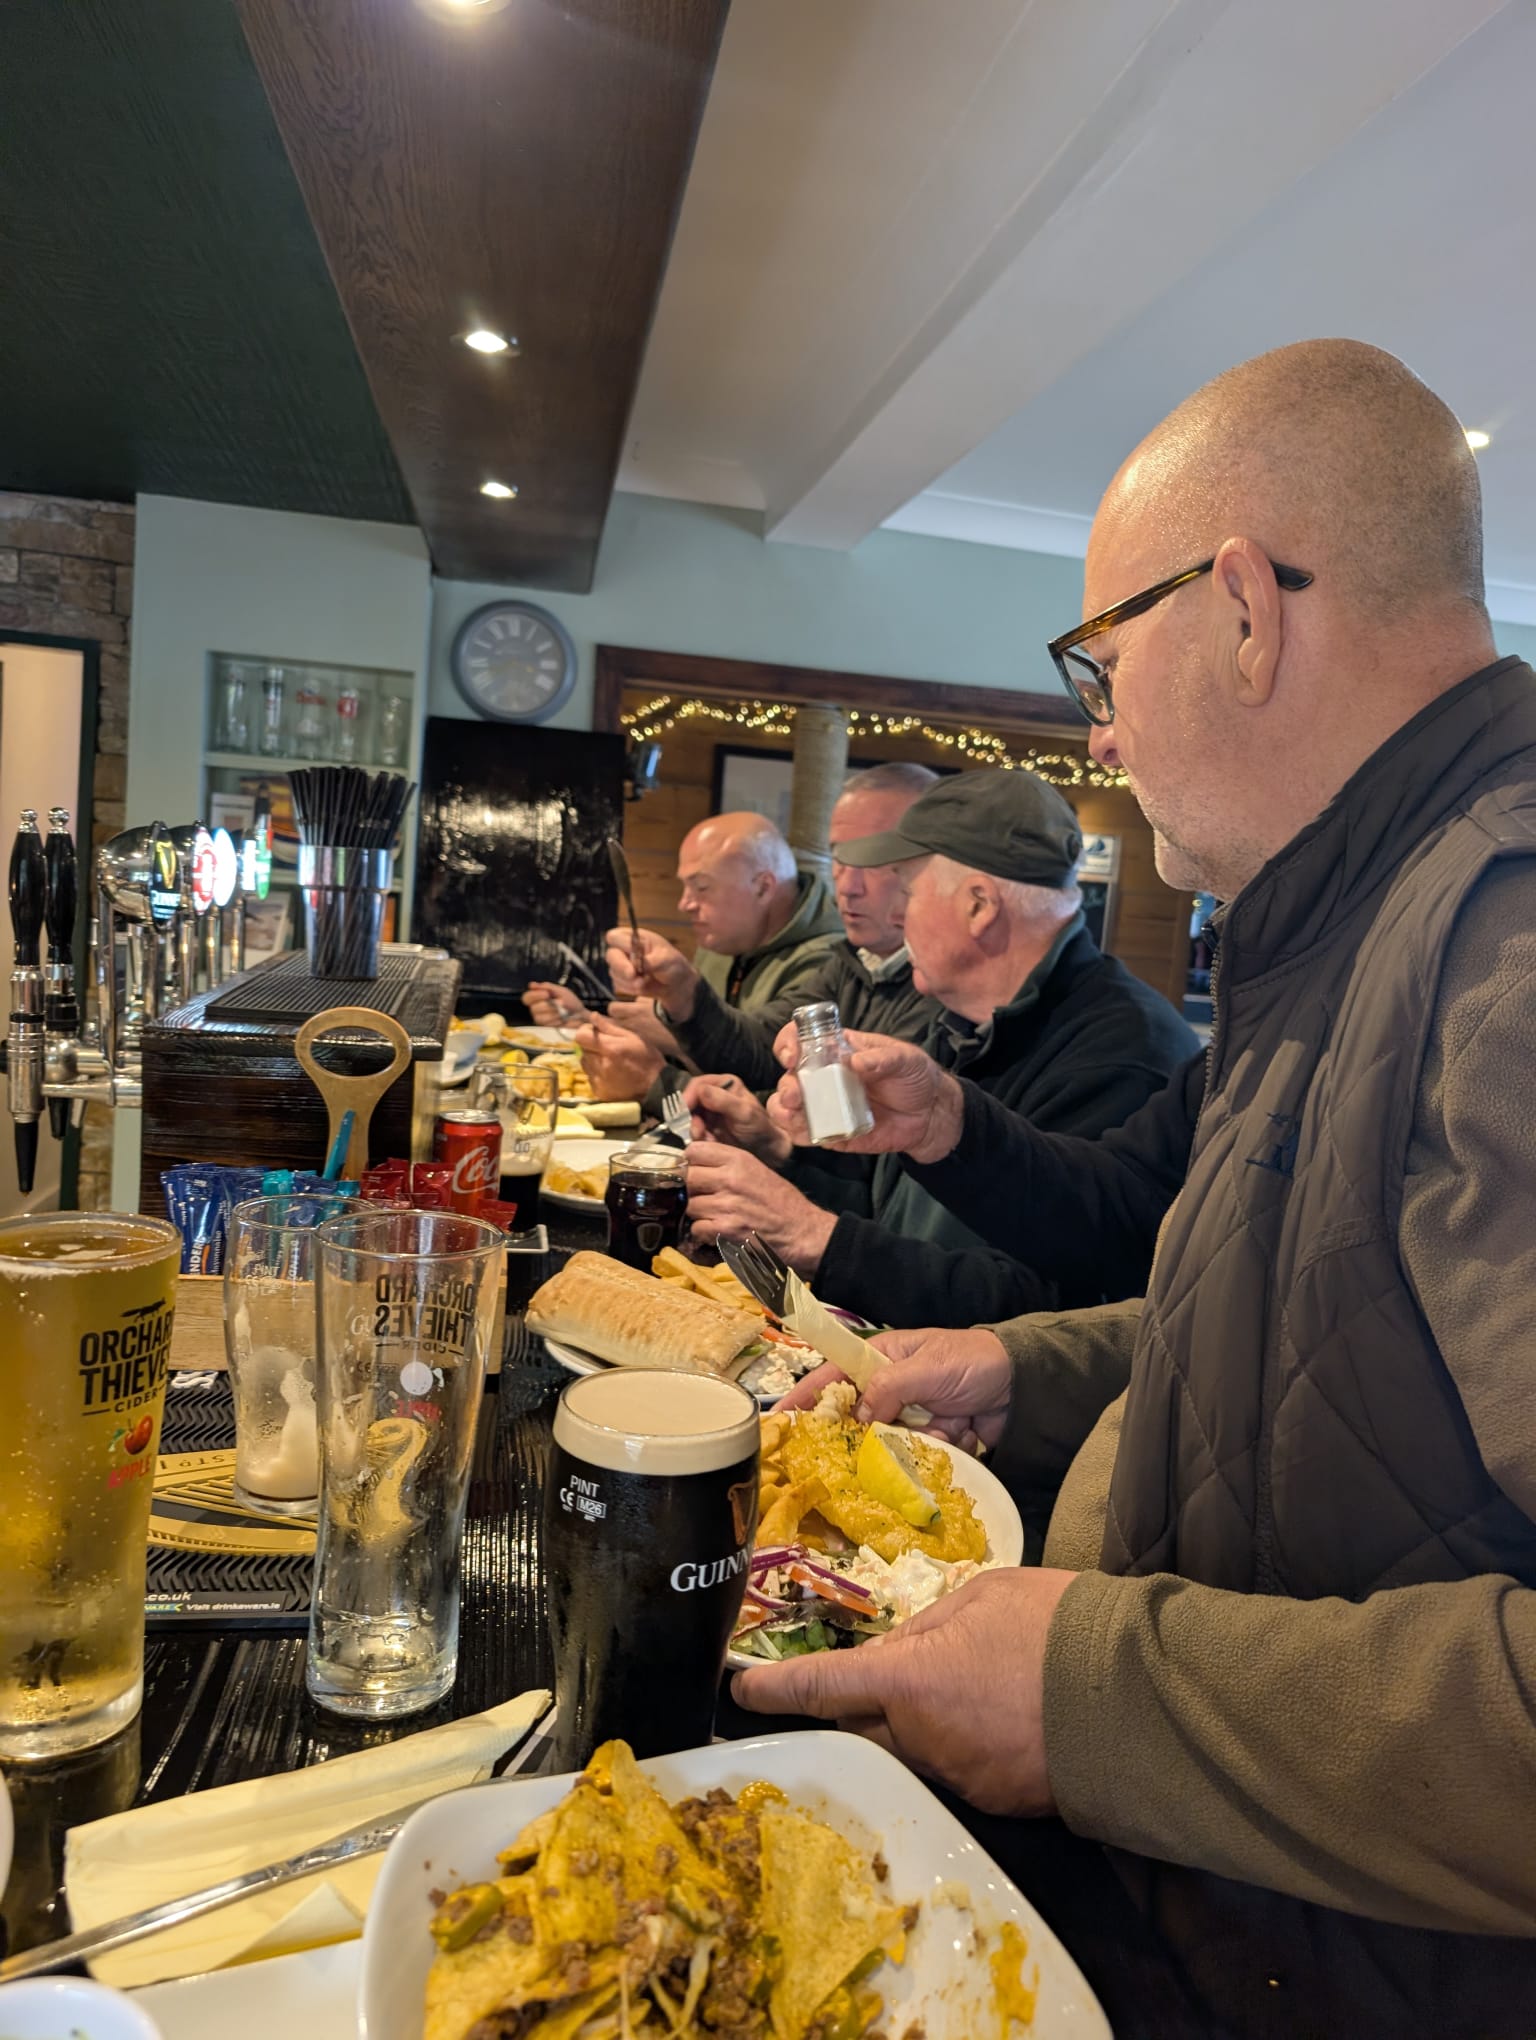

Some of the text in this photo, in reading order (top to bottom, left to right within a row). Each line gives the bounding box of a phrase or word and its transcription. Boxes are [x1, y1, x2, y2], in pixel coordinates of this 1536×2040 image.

[80, 1305, 174, 1366] ORCHAR
[79, 1343, 168, 1405] THIEVE
[115, 1387, 158, 1413] CIDER
[108, 1454, 150, 1490] APPLE
[570, 1474, 600, 1498] PINT
[580, 1499, 603, 1515] M26
[670, 1547, 749, 1592] GUINN
[186, 1602, 280, 1611] Visit drinkaware.ie
